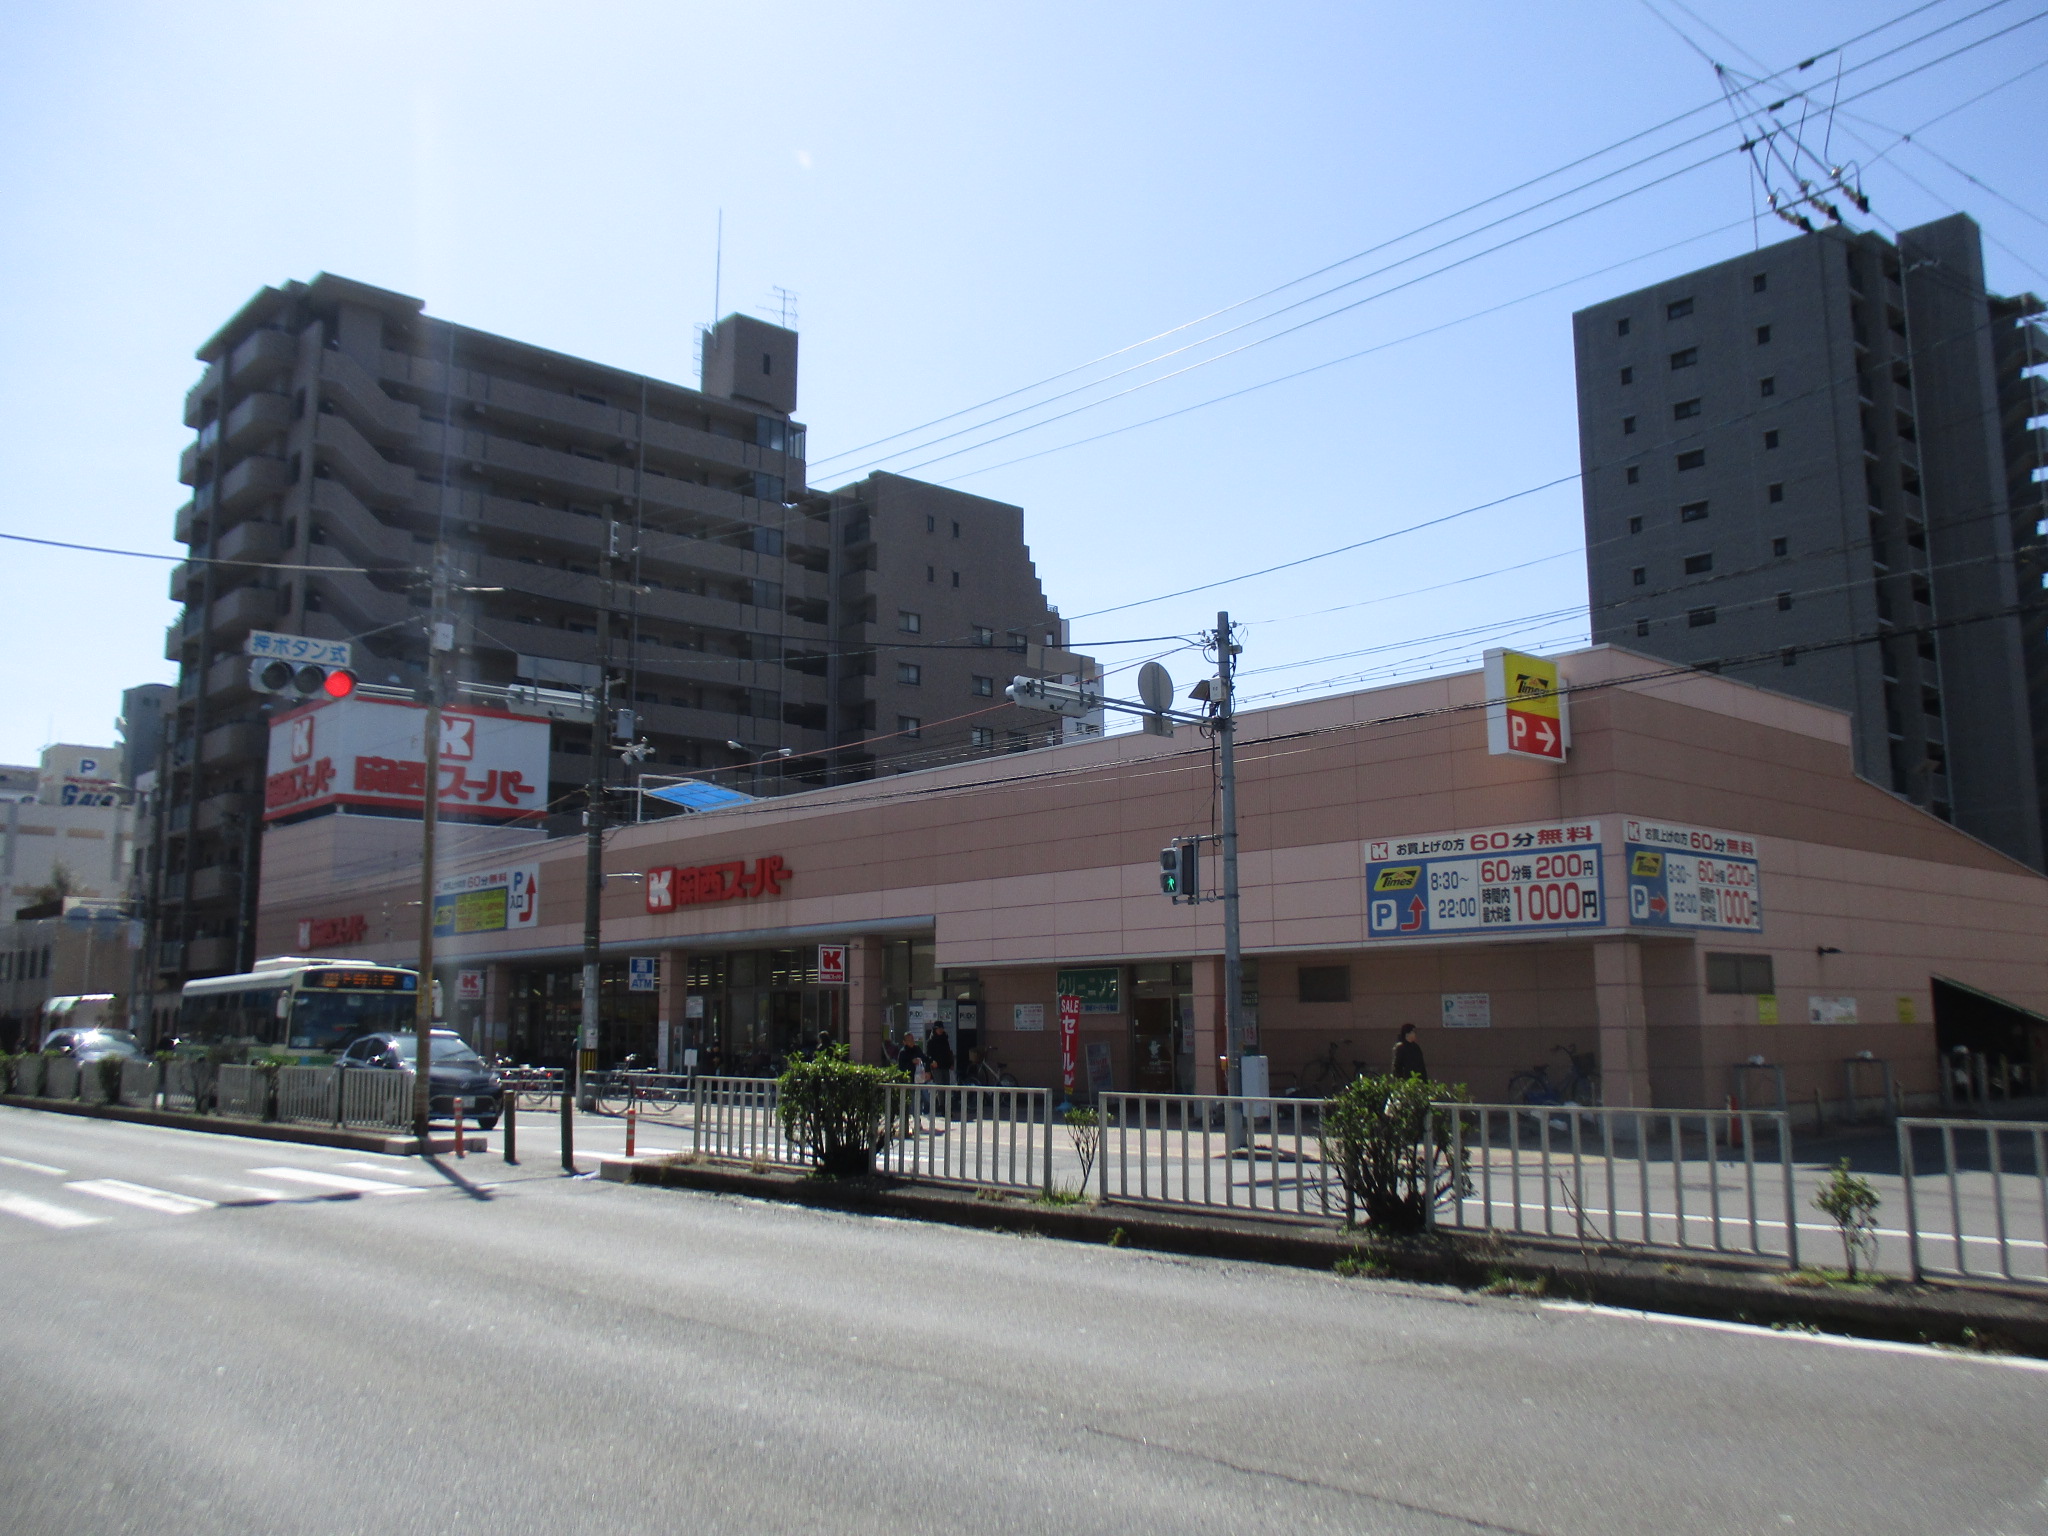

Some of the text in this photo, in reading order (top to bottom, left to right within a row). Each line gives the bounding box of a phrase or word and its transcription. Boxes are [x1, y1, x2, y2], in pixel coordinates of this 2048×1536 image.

[253, 634, 347, 663] 押ボタン式
[1512, 716, 1527, 747] P
[80, 759, 96, 774] P
[1396, 838, 1465, 855] お買上げの方
[513, 871, 524, 892] P
[676, 855, 792, 904] 関西スーパー
[1380, 870, 1418, 888] Times
[510, 895, 524, 909] 入口
[1438, 898, 1477, 918] 22:00
[1513, 882, 1598, 921] 1000円
[1634, 889, 1645, 915] P
[1376, 903, 1392, 927] P
[822, 950, 842, 970] K
[462, 974, 479, 989] K
[631, 979, 652, 989] ATM
[1061, 1000, 1079, 1013] SALE
[1062, 1015, 1075, 1071] セール
